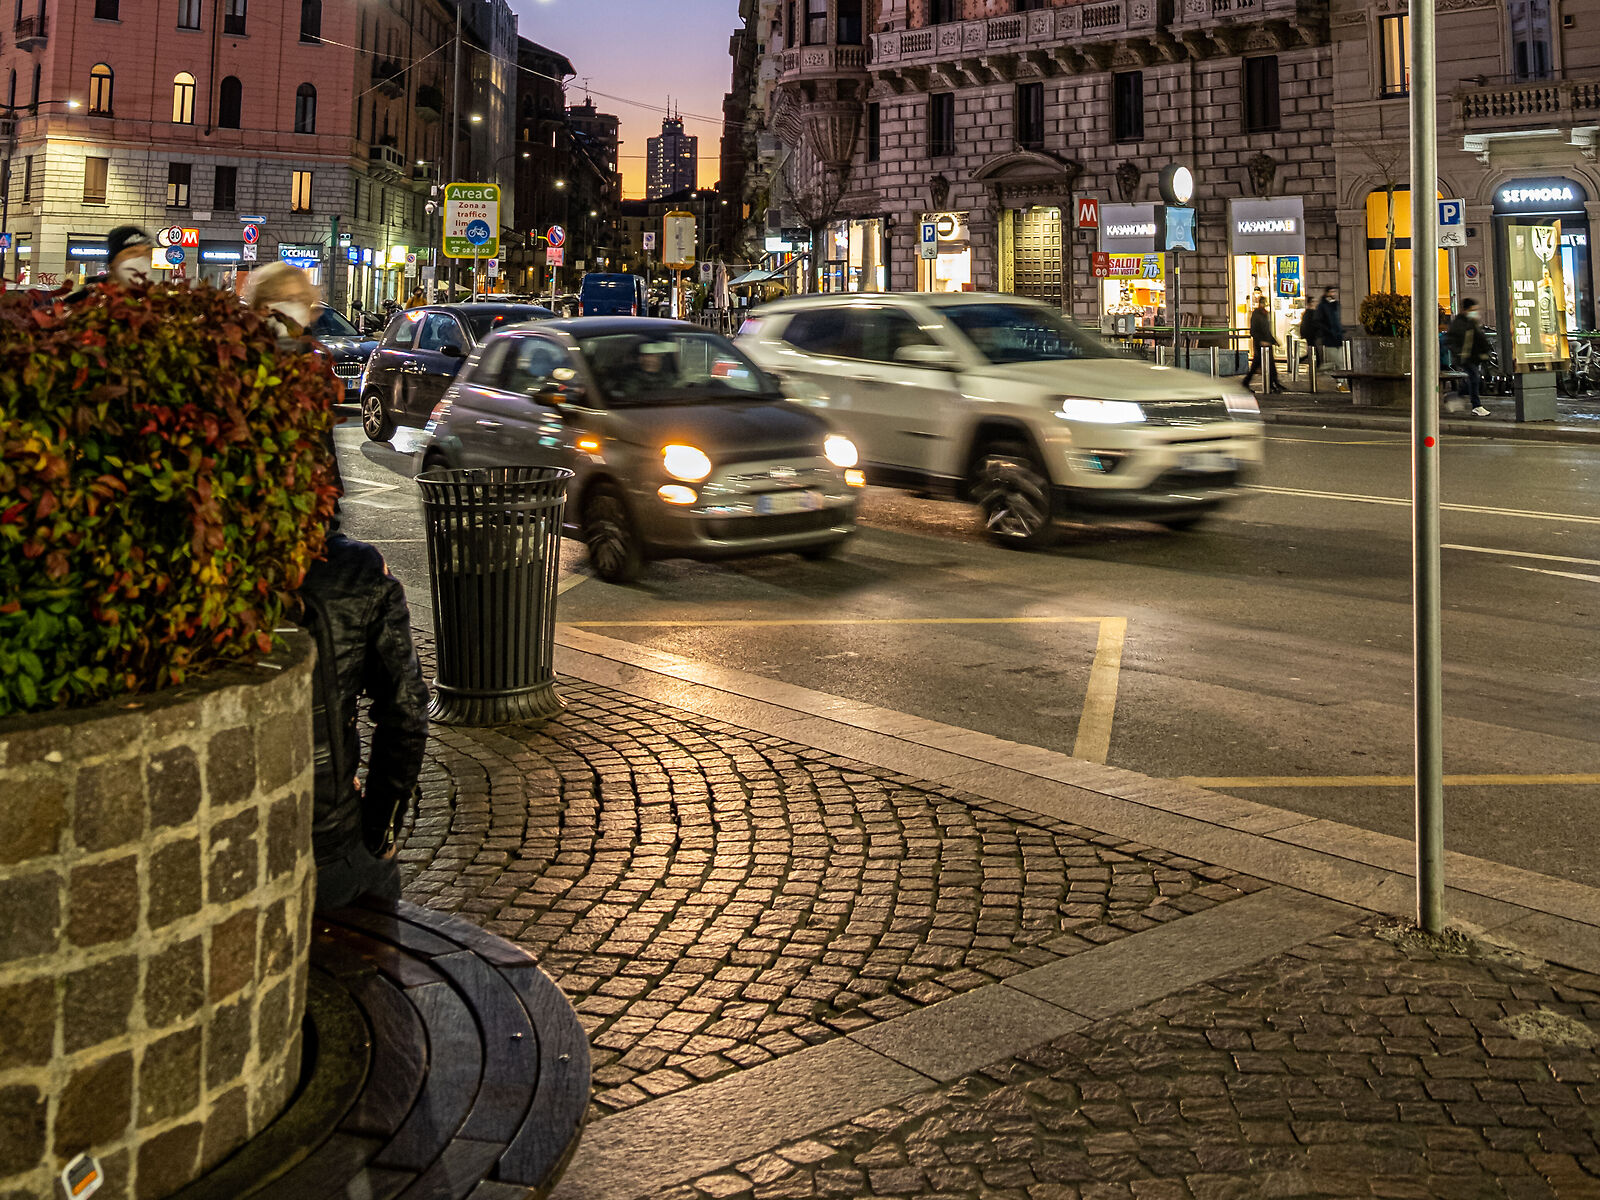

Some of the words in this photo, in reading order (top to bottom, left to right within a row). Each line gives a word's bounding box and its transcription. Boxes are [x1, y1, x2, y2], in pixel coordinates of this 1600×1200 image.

[1502, 187, 1573, 203] SEPHORA
[1080, 203, 1097, 221] M
[1443, 204, 1457, 223] P
[1106, 224, 1148, 236] KASANOVA
[1238, 220, 1285, 233] KASANOVA
[170, 231, 180, 239] 30
[183, 232, 197, 243] M
[925, 226, 933, 241] P
[281, 249, 319, 258] OCCHIALI
[1282, 282, 1294, 292] TV
